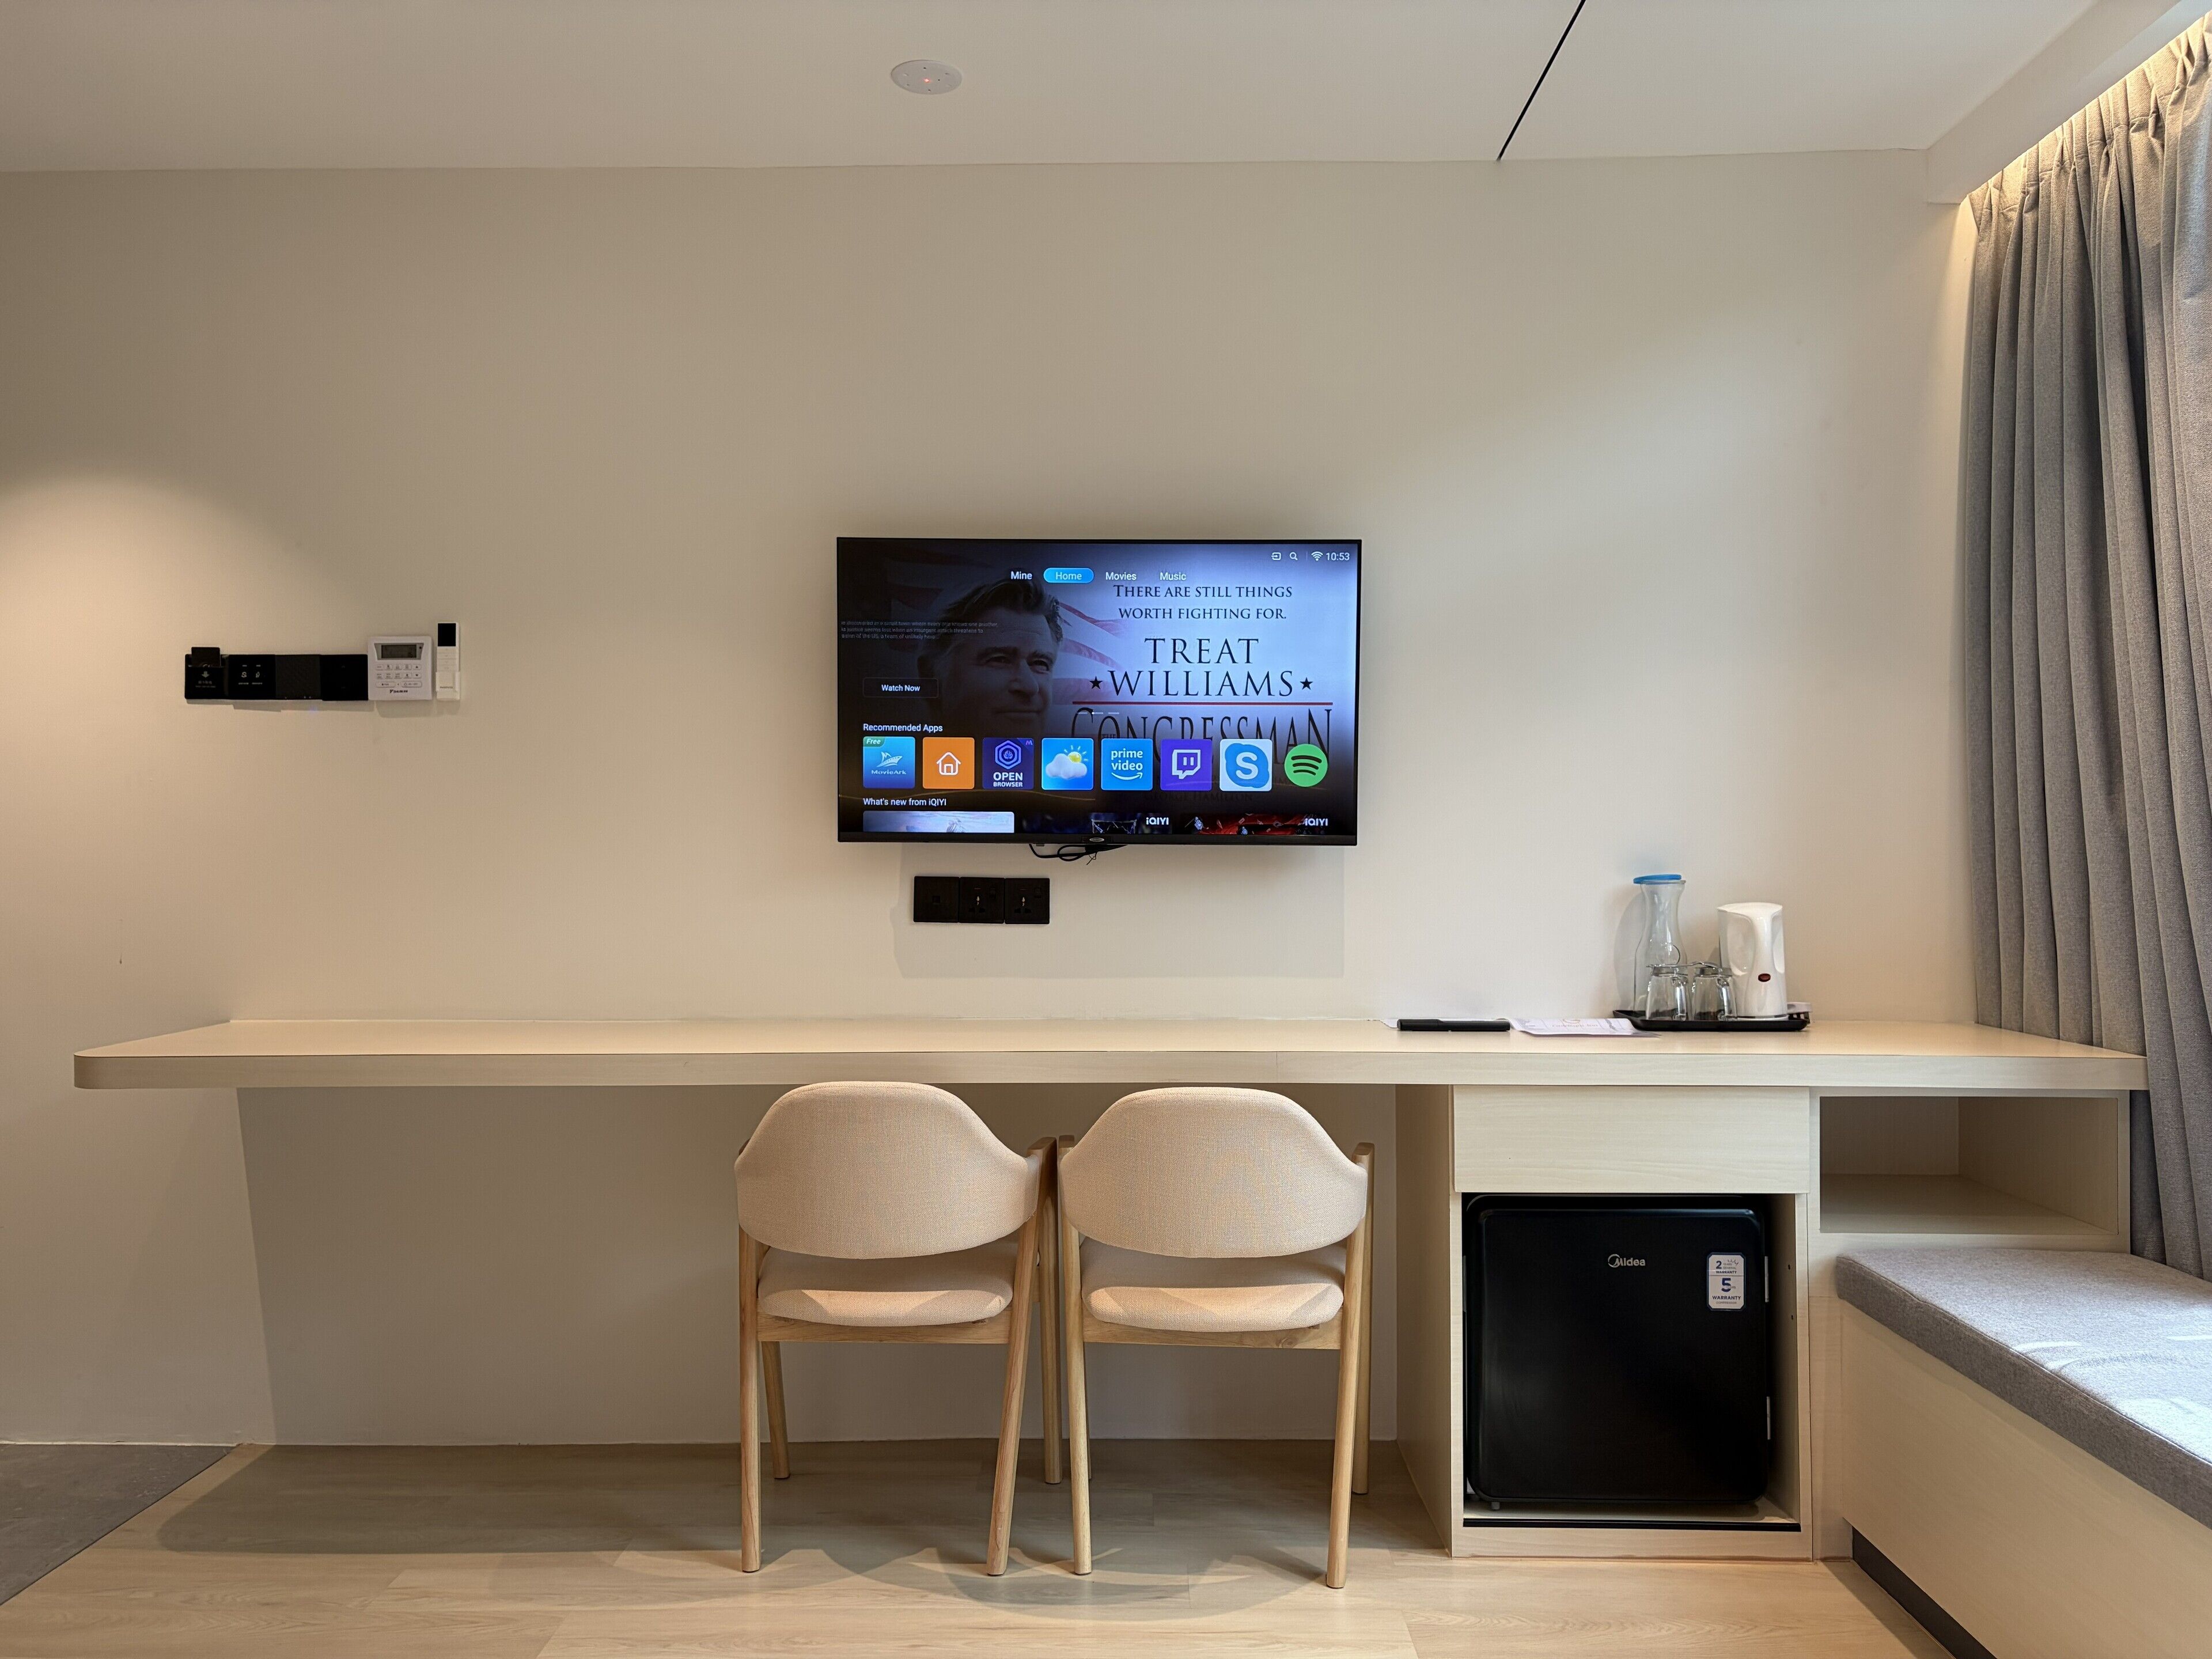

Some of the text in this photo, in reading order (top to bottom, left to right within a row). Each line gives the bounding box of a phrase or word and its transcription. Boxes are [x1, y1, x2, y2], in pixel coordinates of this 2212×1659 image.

[1325, 552, 1350, 561] 10:53
[1010, 571, 1187, 581] Mine Home Movies Music
[1113, 584, 1293, 598] THERE ARE STILL THINGS
[1118, 608, 1287, 620] WORTH FIGHTING FOR.
[1144, 638, 1259, 665] TREAT
[1107, 670, 1293, 697] WILLIAMS
[863, 724, 943, 733] Recommended Apps
[1111, 748, 1143, 760] prime
[1111, 761, 1143, 771] video
[993, 772, 1023, 781] OPEN
[863, 798, 889, 806] What's
[908, 798, 927, 806] from
[929, 798, 947, 806] iQIYI
[1146, 817, 1169, 825] iQIYI
[1305, 818, 1328, 827] iQIYI
[1611, 1255, 1646, 1268] Midea
[1715, 1260, 1722, 1269] 2
[1721, 1277, 1732, 1293] 5
